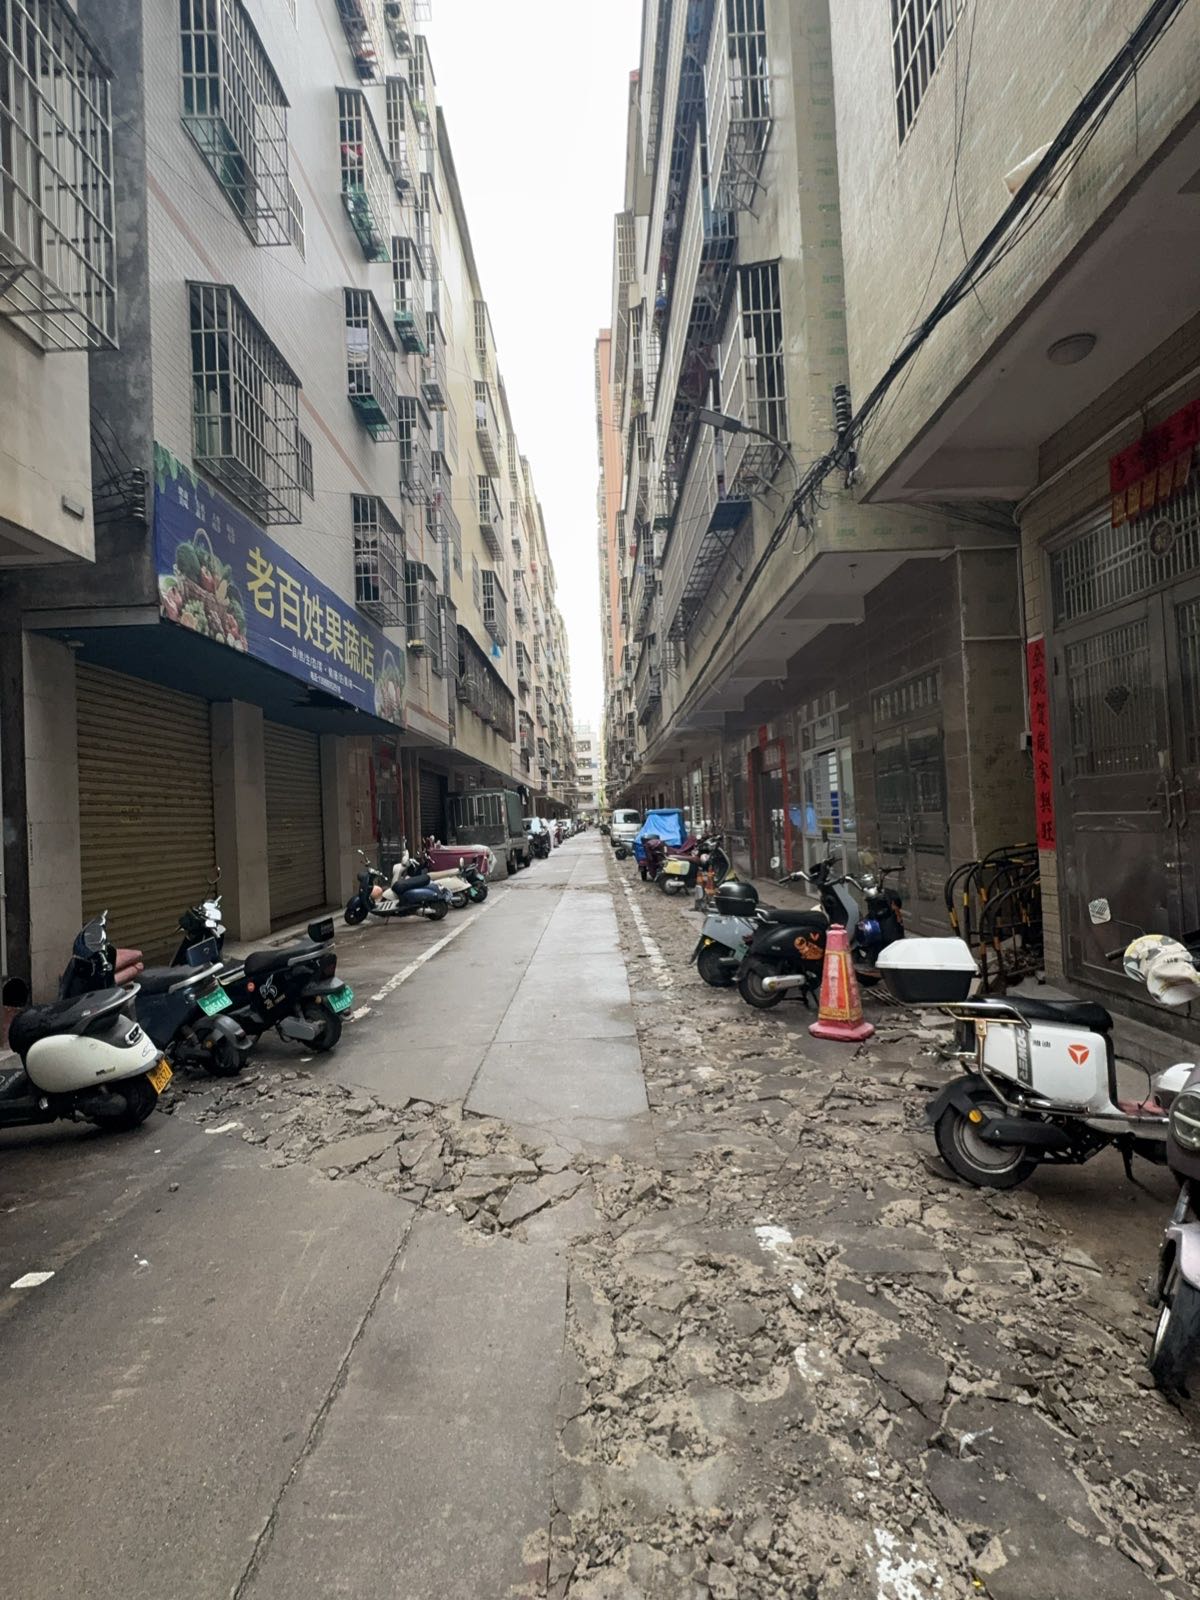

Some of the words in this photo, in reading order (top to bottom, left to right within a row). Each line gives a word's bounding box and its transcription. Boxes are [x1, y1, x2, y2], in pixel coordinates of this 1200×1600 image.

[246, 546, 374, 684] 老百姓果蔬店
